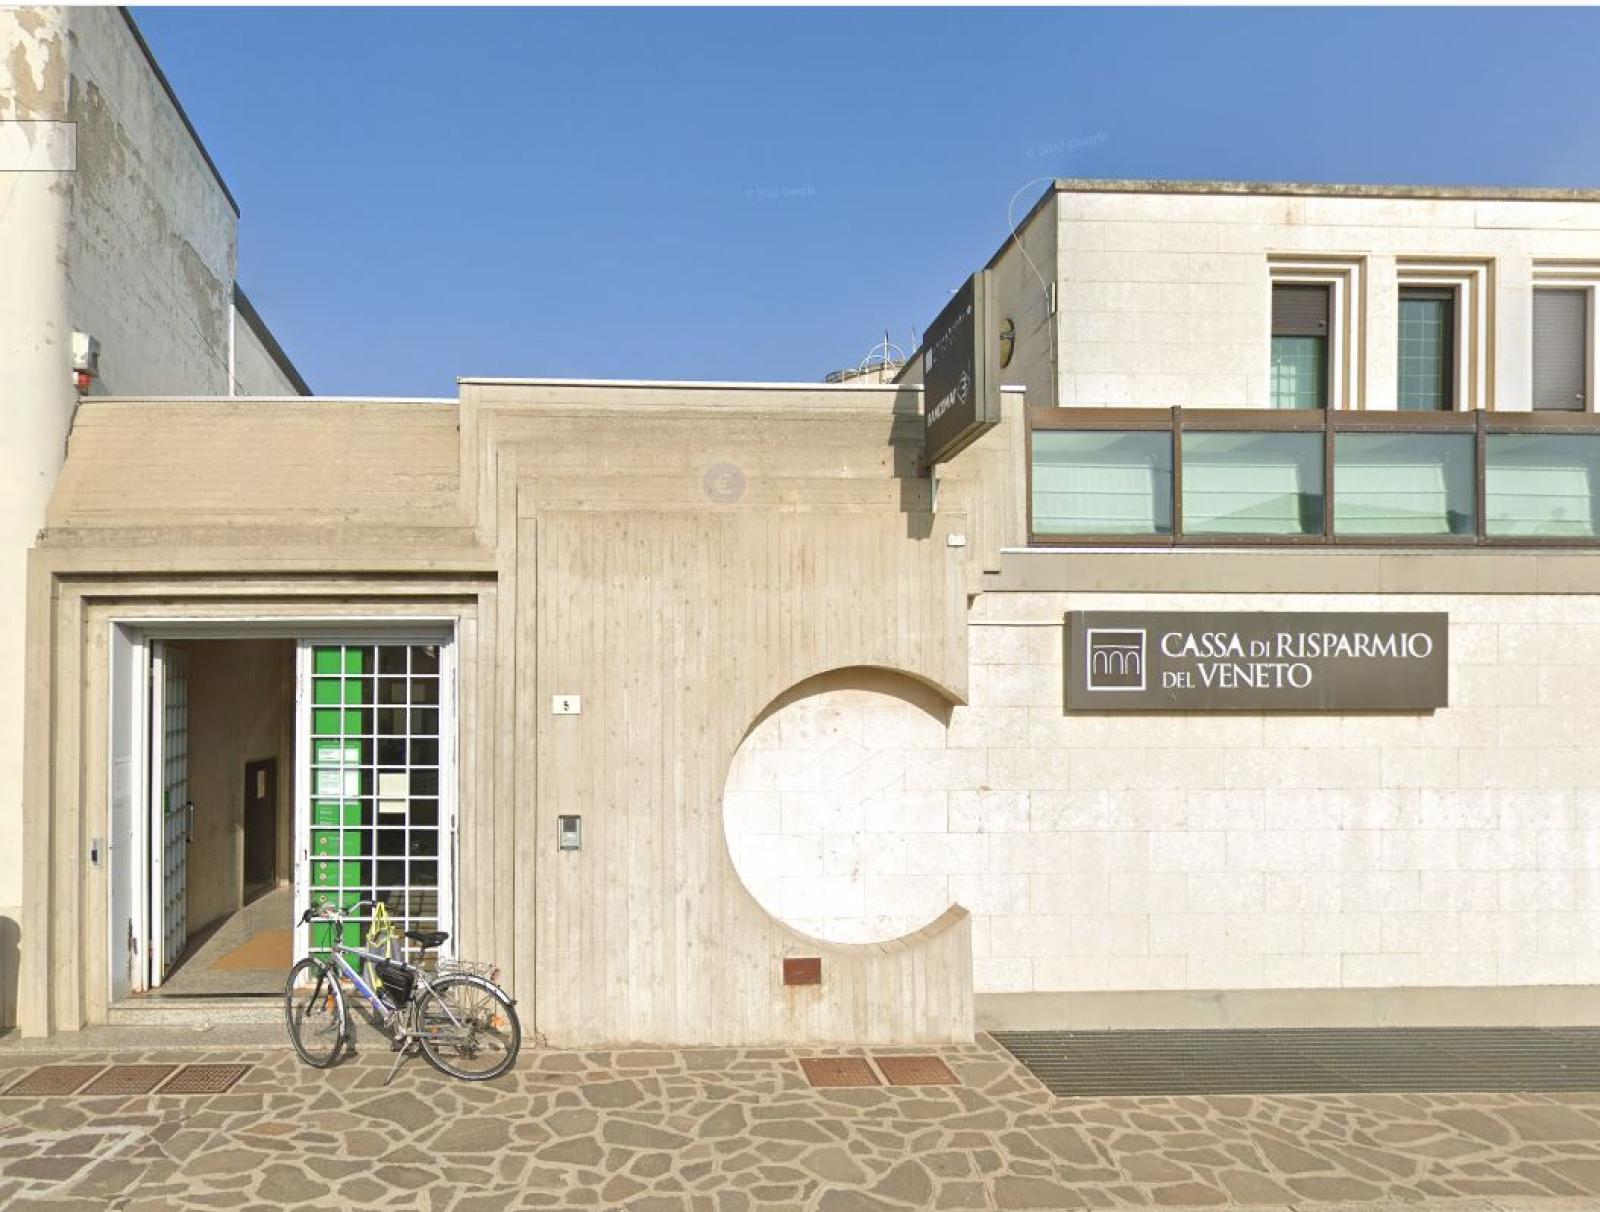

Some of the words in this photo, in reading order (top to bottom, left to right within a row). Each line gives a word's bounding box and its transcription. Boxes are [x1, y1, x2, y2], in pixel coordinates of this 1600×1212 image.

[1160, 631, 1246, 659] CASSA
[1250, 640, 1271, 658] DI
[1276, 631, 1433, 659] RISPARMIO
[1162, 671, 1196, 689] DEL
[1196, 662, 1313, 689] VENETO
